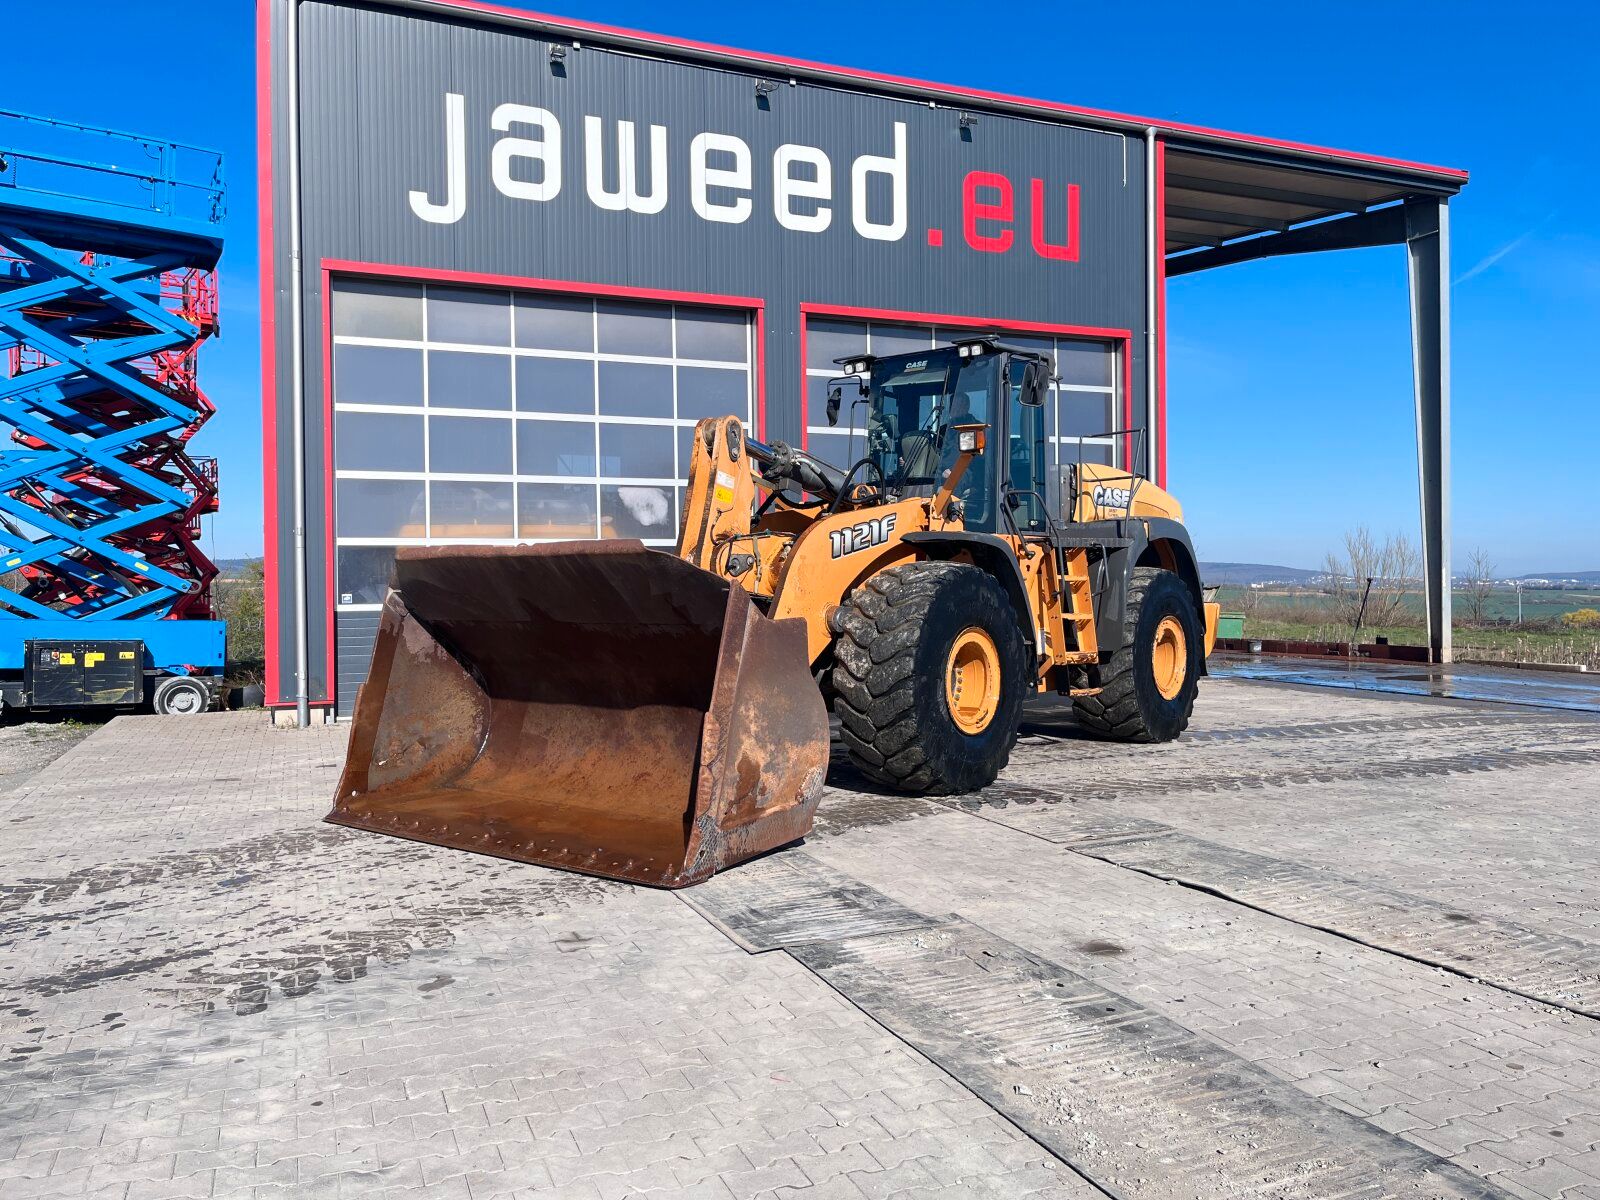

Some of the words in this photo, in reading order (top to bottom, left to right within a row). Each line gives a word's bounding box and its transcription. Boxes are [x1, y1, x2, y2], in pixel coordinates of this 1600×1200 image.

[905, 360, 928, 369] CASE
[1093, 484, 1131, 509] CASE
[829, 512, 897, 559] 1121F
